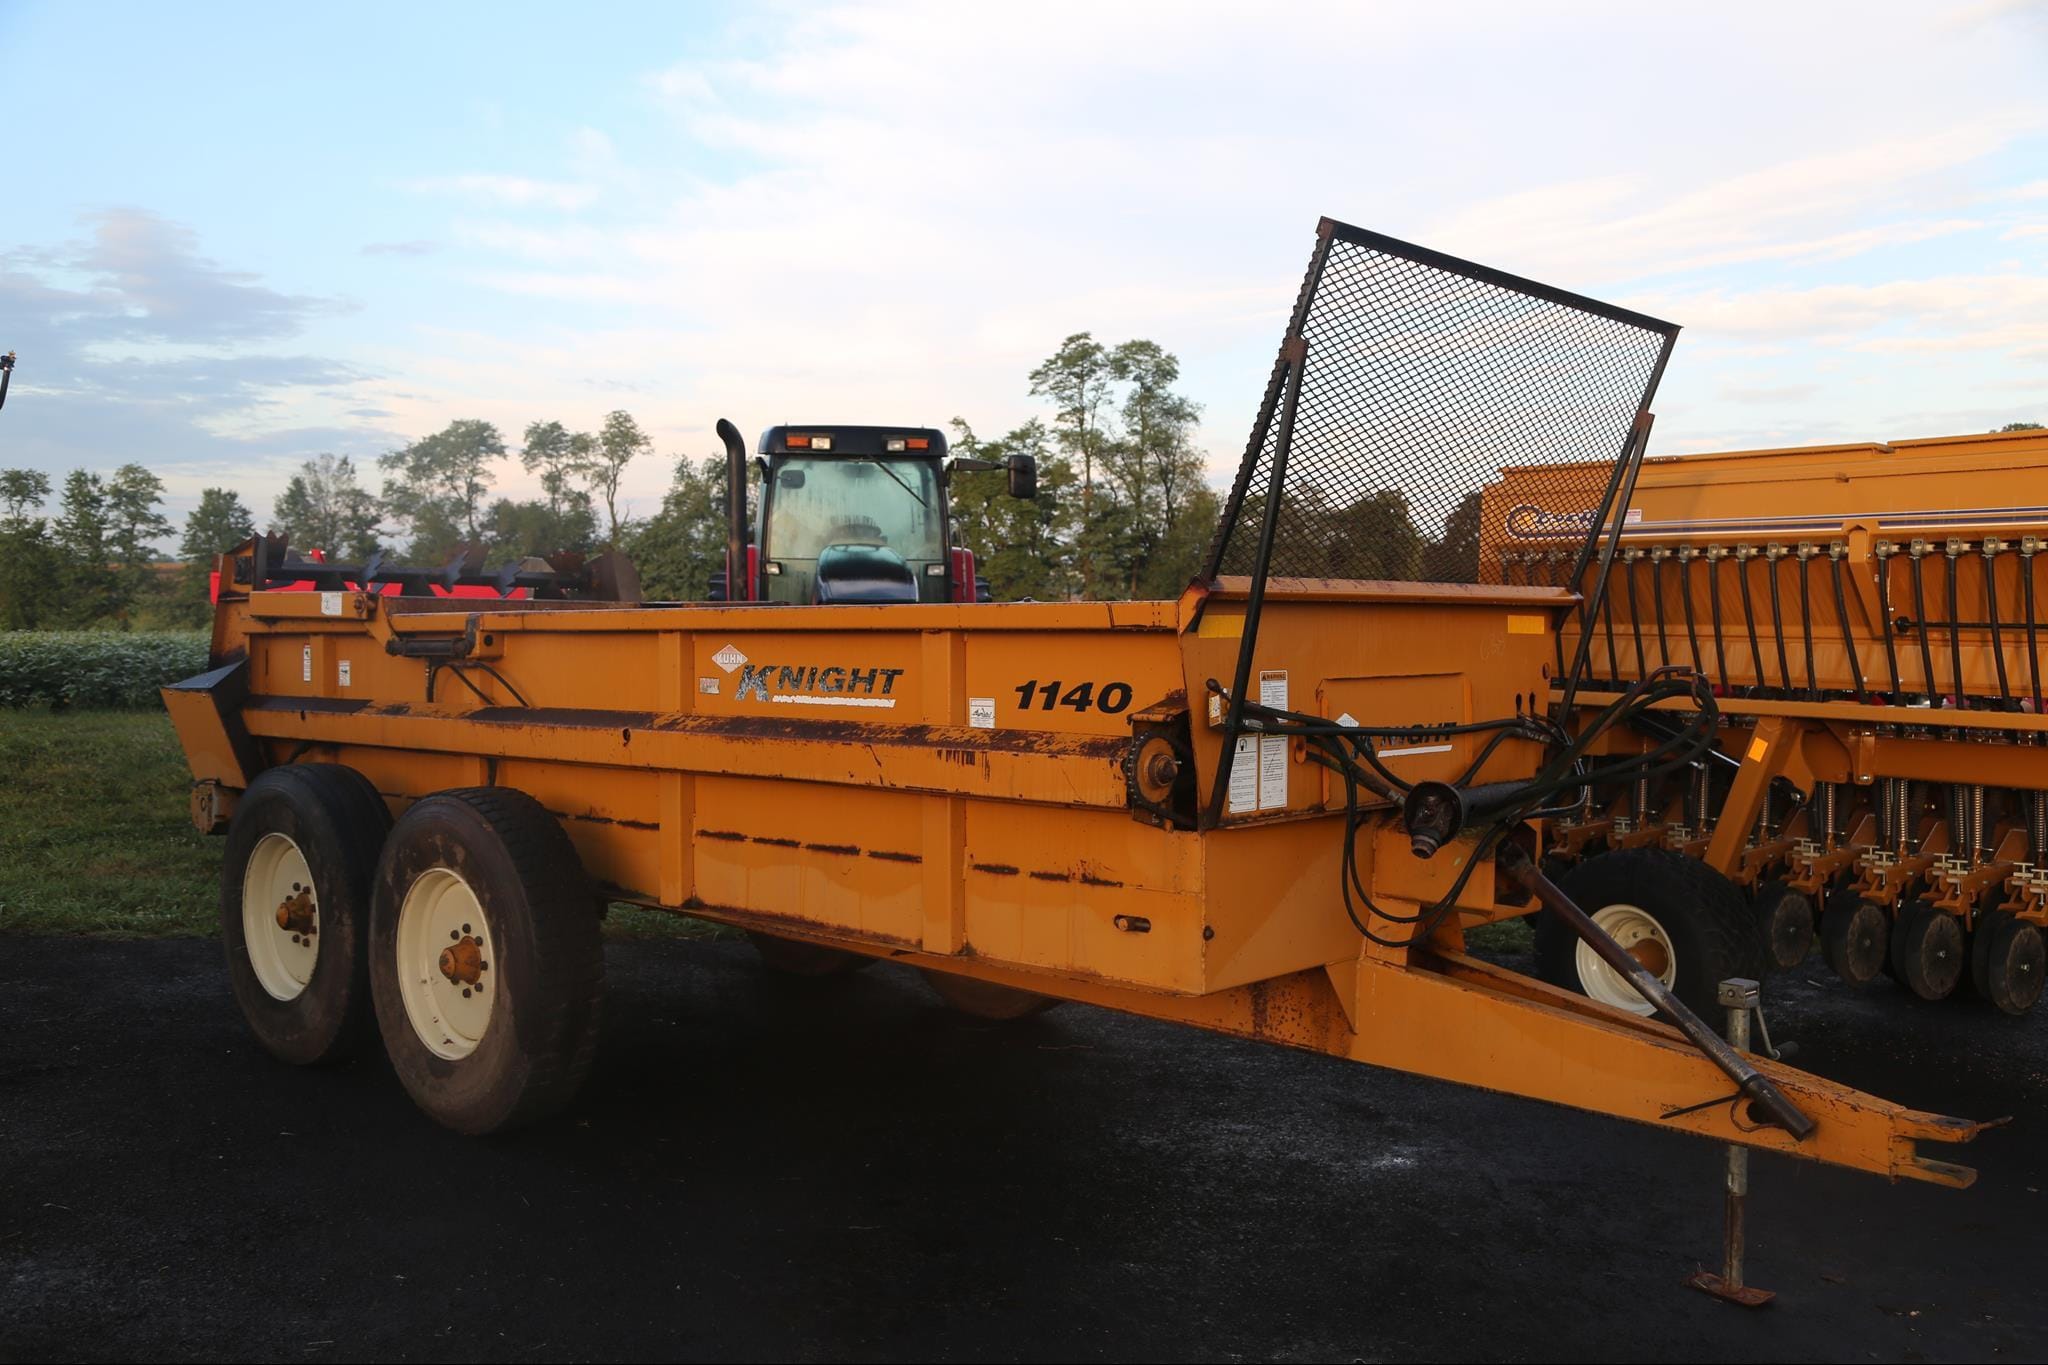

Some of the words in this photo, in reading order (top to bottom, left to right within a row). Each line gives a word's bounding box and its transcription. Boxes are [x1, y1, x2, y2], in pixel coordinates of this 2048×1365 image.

[716, 653, 743, 664] KUHN
[735, 665, 904, 702] KNIGHT
[1015, 680, 1133, 714] 1140
